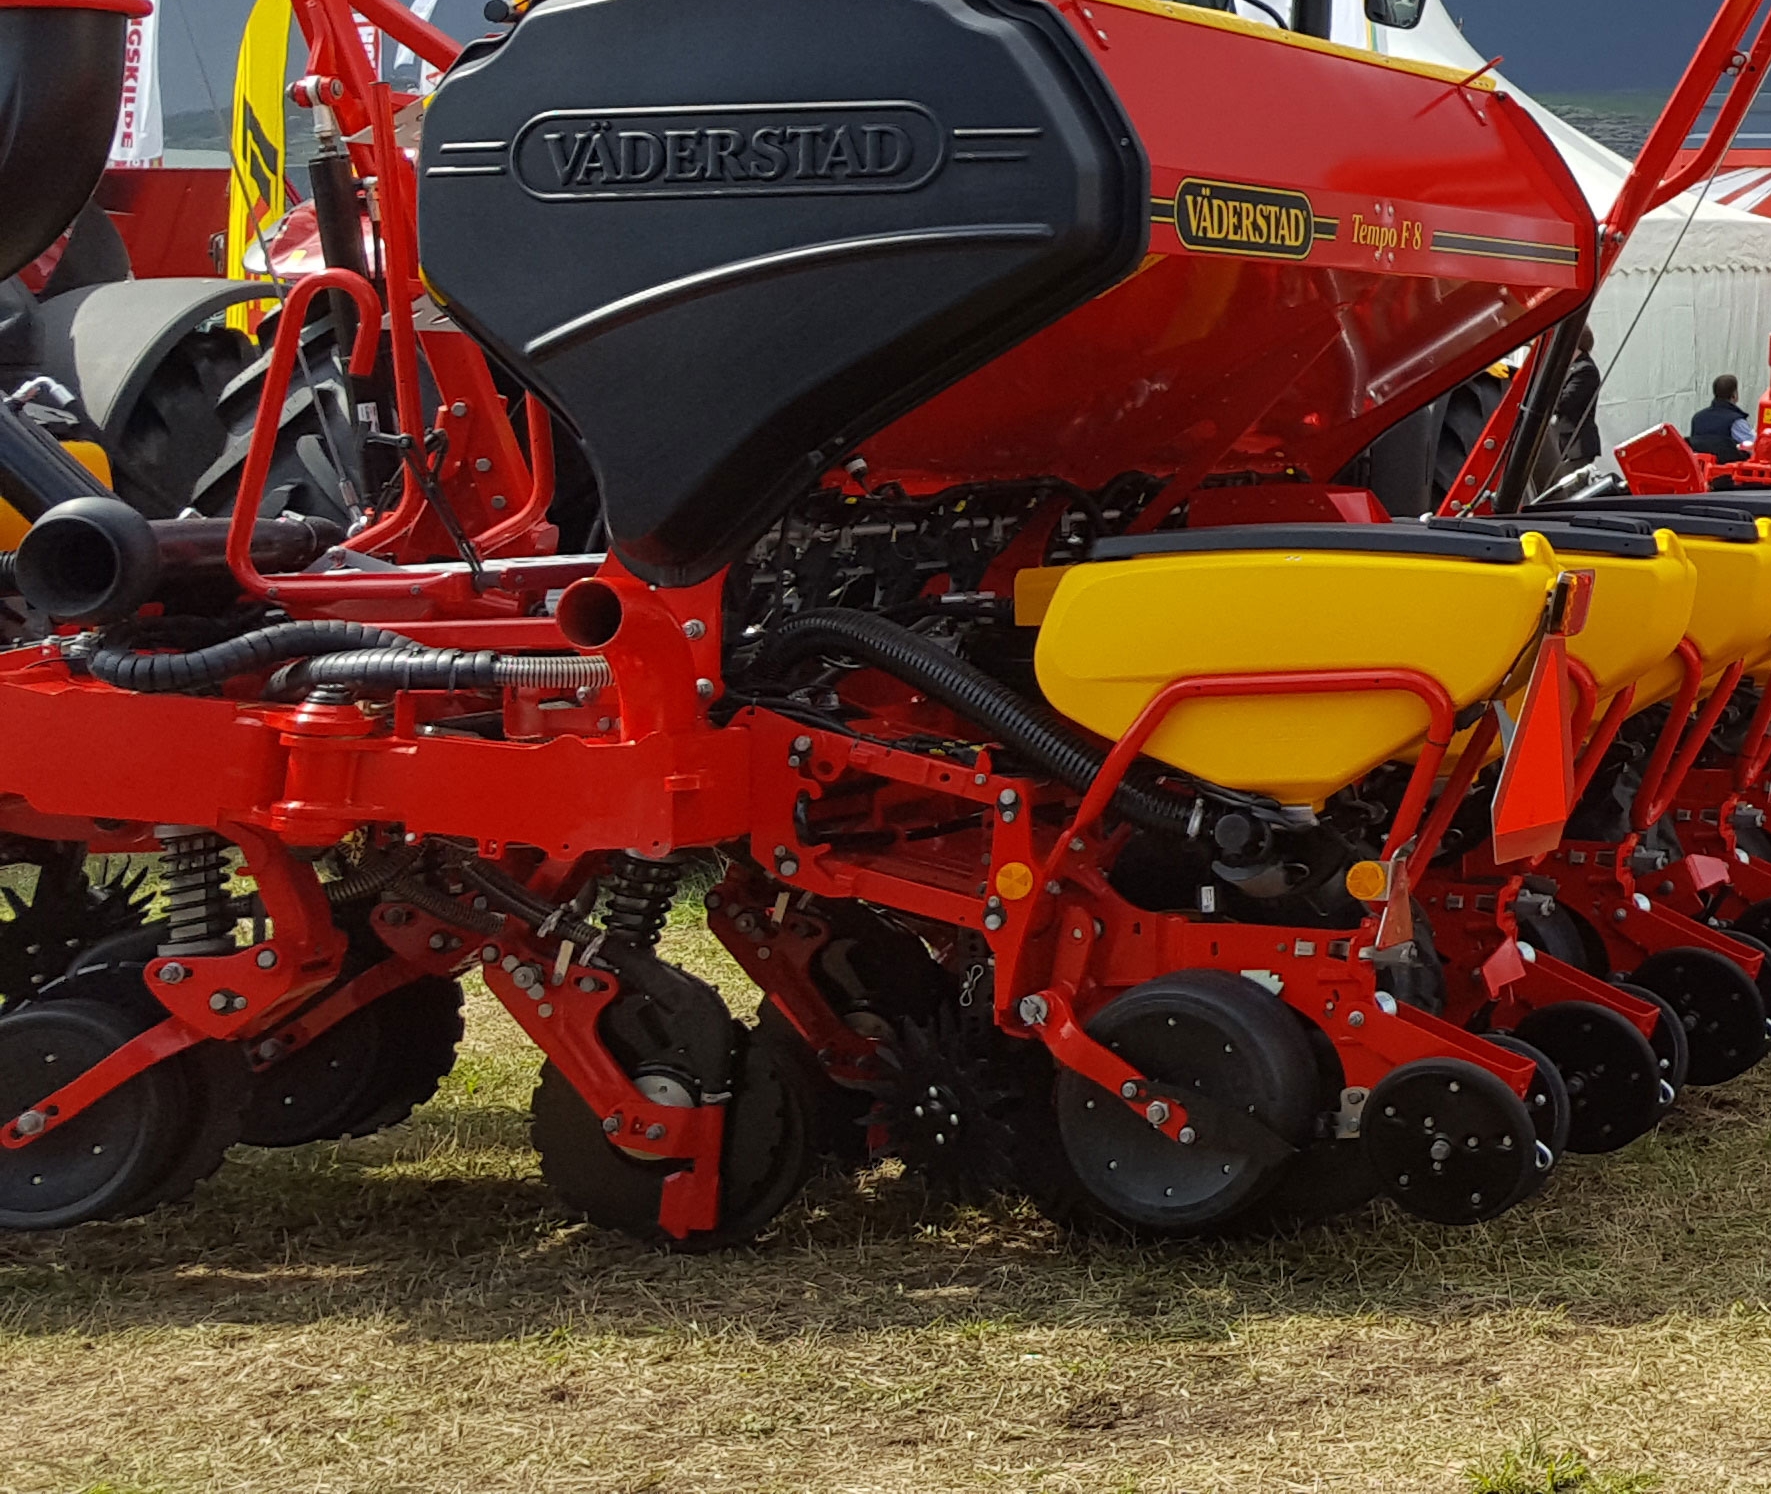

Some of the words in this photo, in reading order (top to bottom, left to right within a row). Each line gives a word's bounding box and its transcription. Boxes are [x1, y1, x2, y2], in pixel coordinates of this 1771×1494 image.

[543, 121, 914, 186] VÄDERSTAD
[1185, 187, 1306, 247] VÄDERSTAD
[1352, 214, 1397, 254] Tempo
[1401, 220, 1411, 249] F
[1413, 221, 1422, 250] 8
